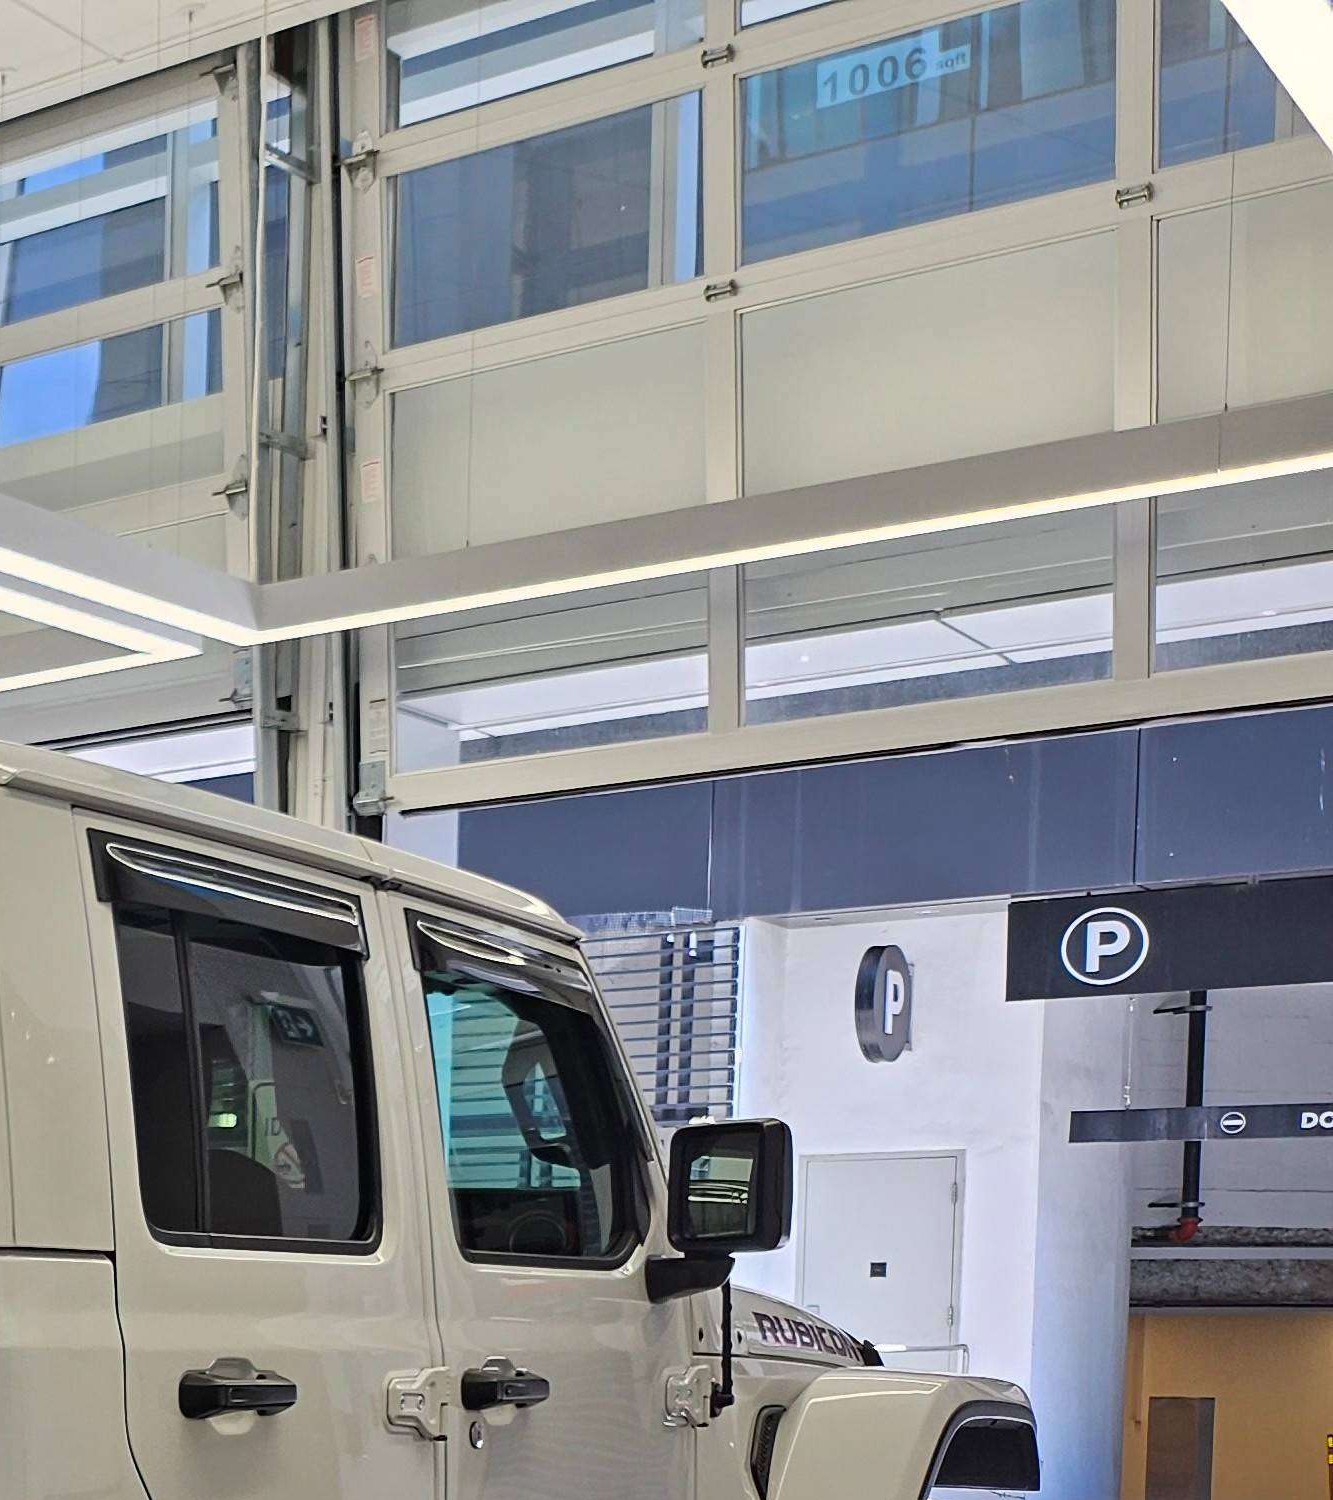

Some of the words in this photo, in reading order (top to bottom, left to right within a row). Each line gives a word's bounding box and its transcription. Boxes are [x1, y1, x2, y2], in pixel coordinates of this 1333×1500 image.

[822, 47, 928, 103] 1006
[1085, 920, 1131, 974] P
[884, 969, 905, 1035] P
